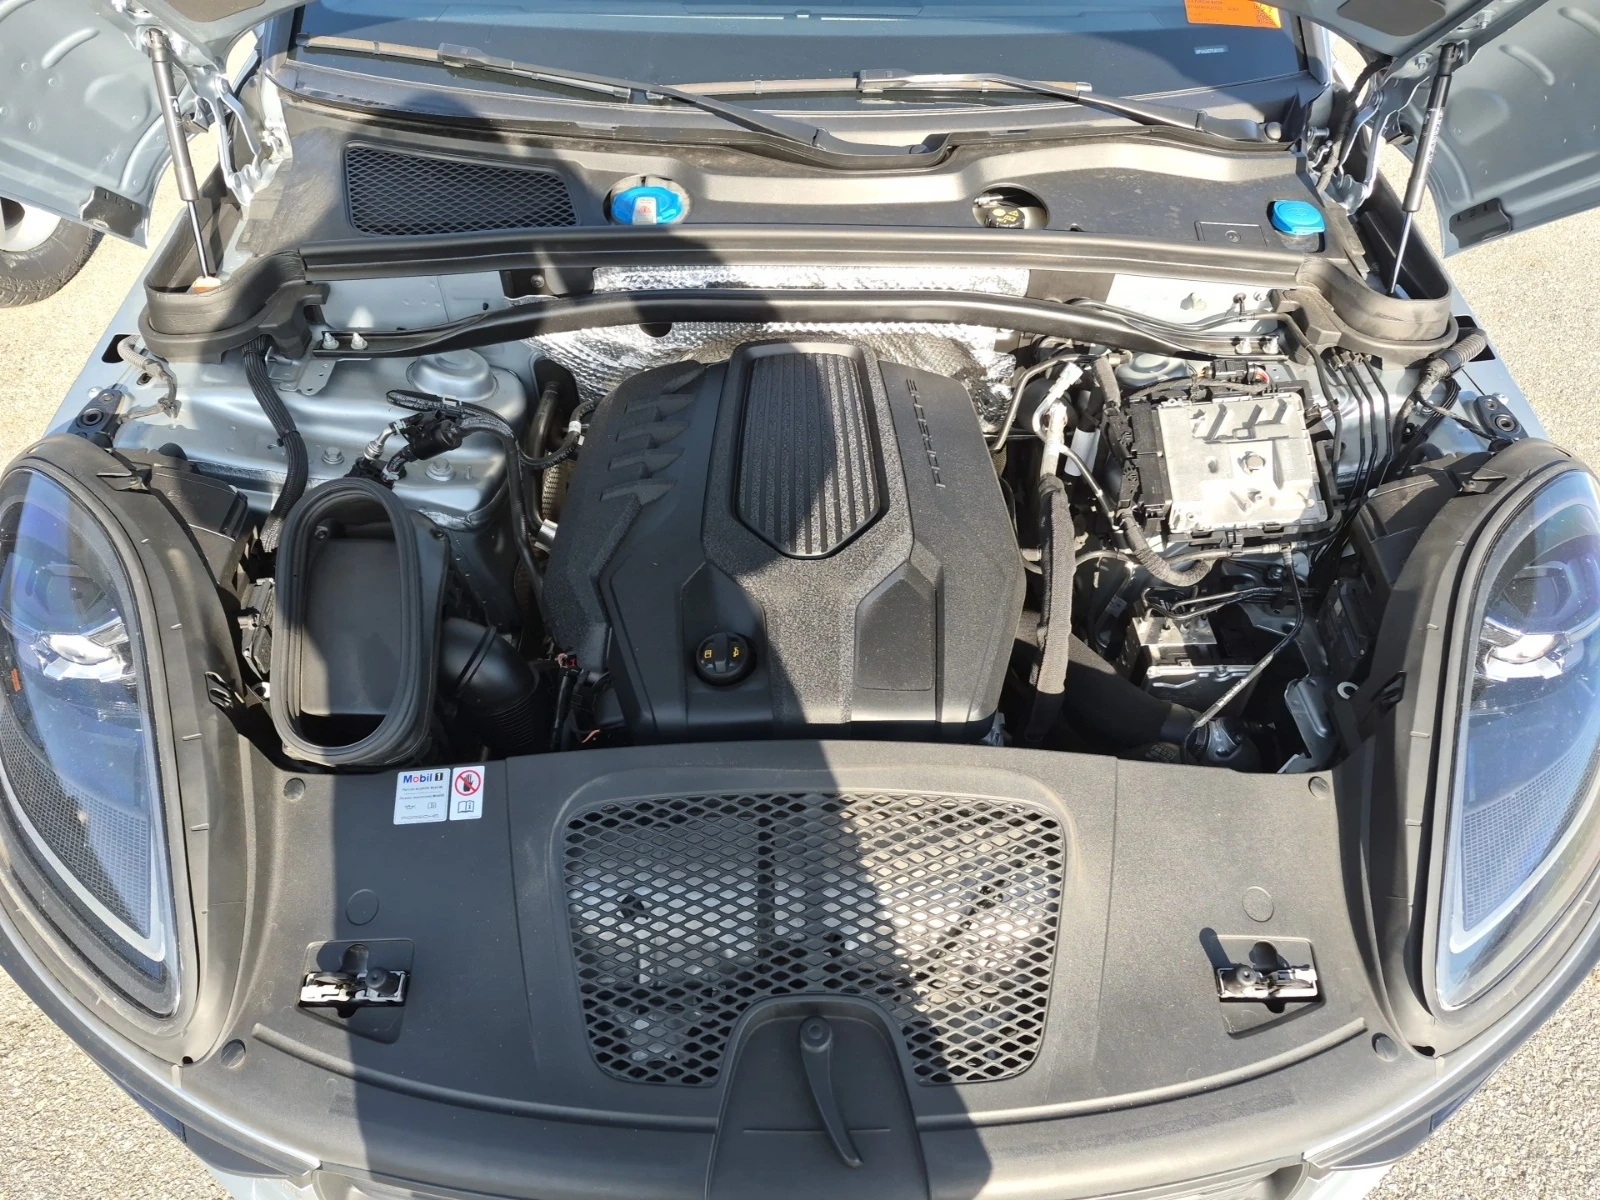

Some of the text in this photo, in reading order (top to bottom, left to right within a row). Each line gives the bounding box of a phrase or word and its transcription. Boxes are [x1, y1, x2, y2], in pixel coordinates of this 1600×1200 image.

[905, 378, 946, 489] PORSCHE
[403, 772, 443, 784] Mobil 1
